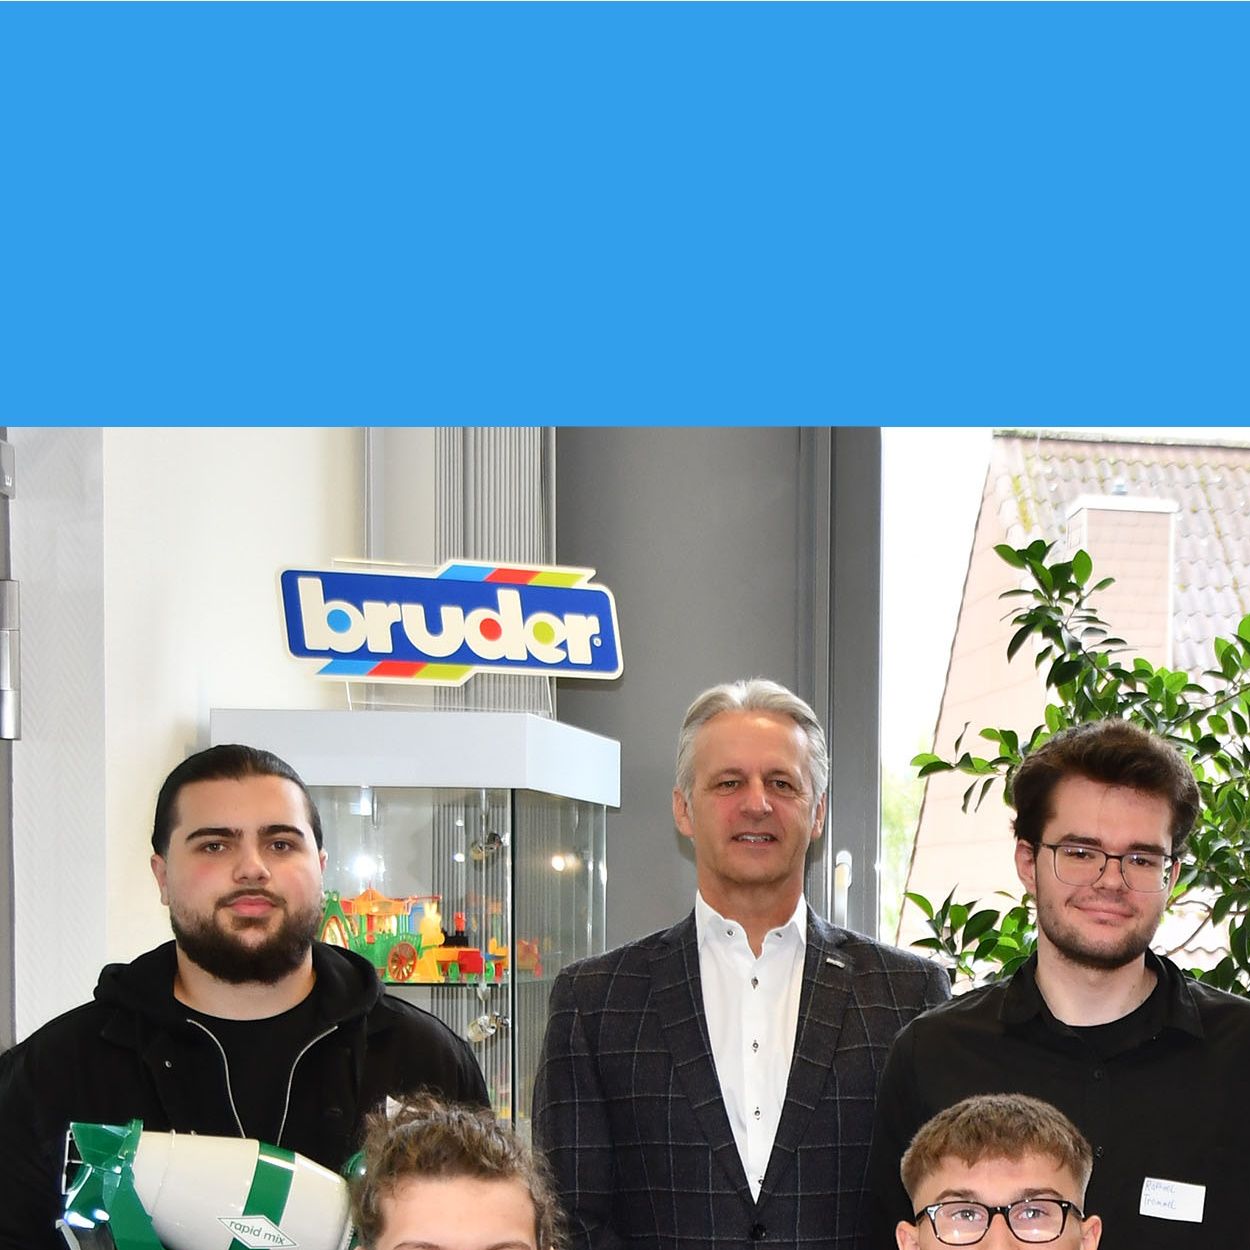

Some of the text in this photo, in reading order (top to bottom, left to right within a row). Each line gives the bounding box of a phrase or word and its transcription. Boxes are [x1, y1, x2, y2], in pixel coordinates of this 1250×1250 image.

[297, 577, 600, 665] bruder
[230, 1221, 286, 1245] rapid mix
